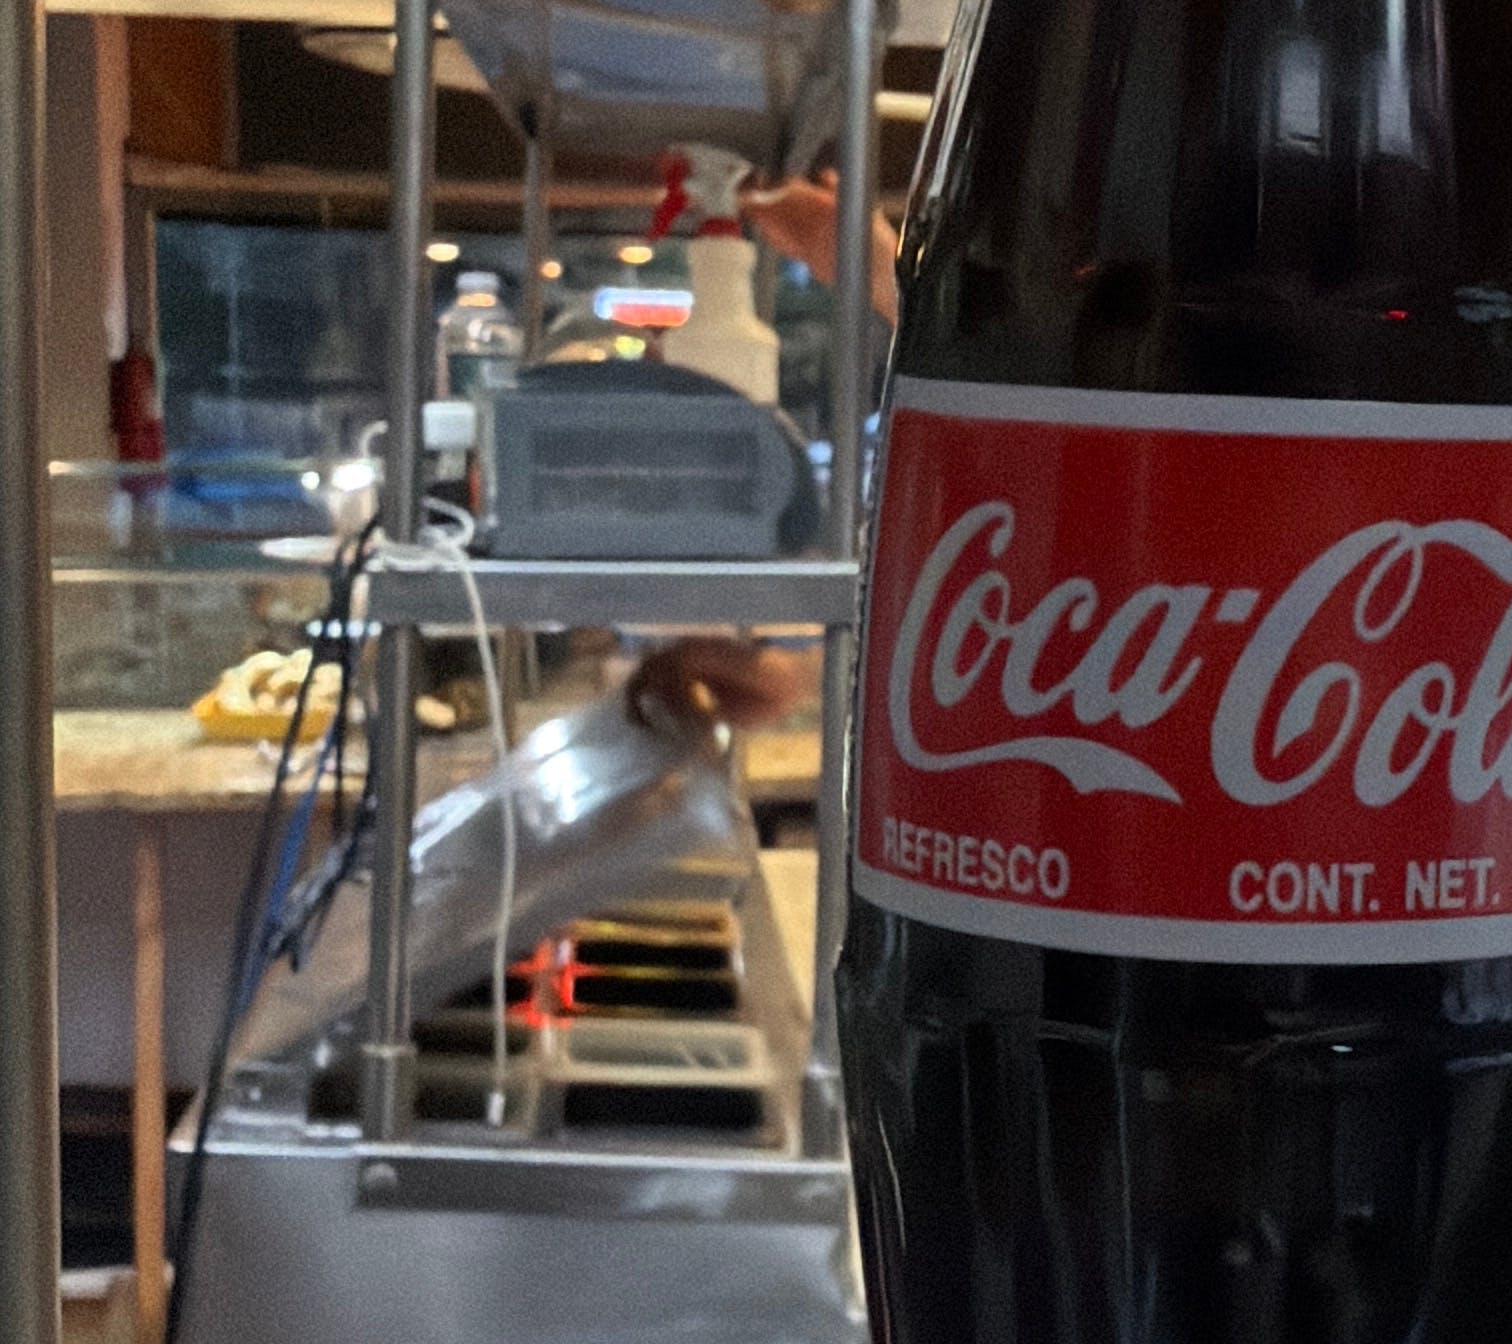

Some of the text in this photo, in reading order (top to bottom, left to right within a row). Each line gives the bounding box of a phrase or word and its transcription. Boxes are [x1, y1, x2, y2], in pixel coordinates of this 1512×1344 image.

[882, 816, 1070, 899] REFRESCO
[1229, 860, 1380, 914] CONT.
[1404, 858, 1500, 911] NET.
